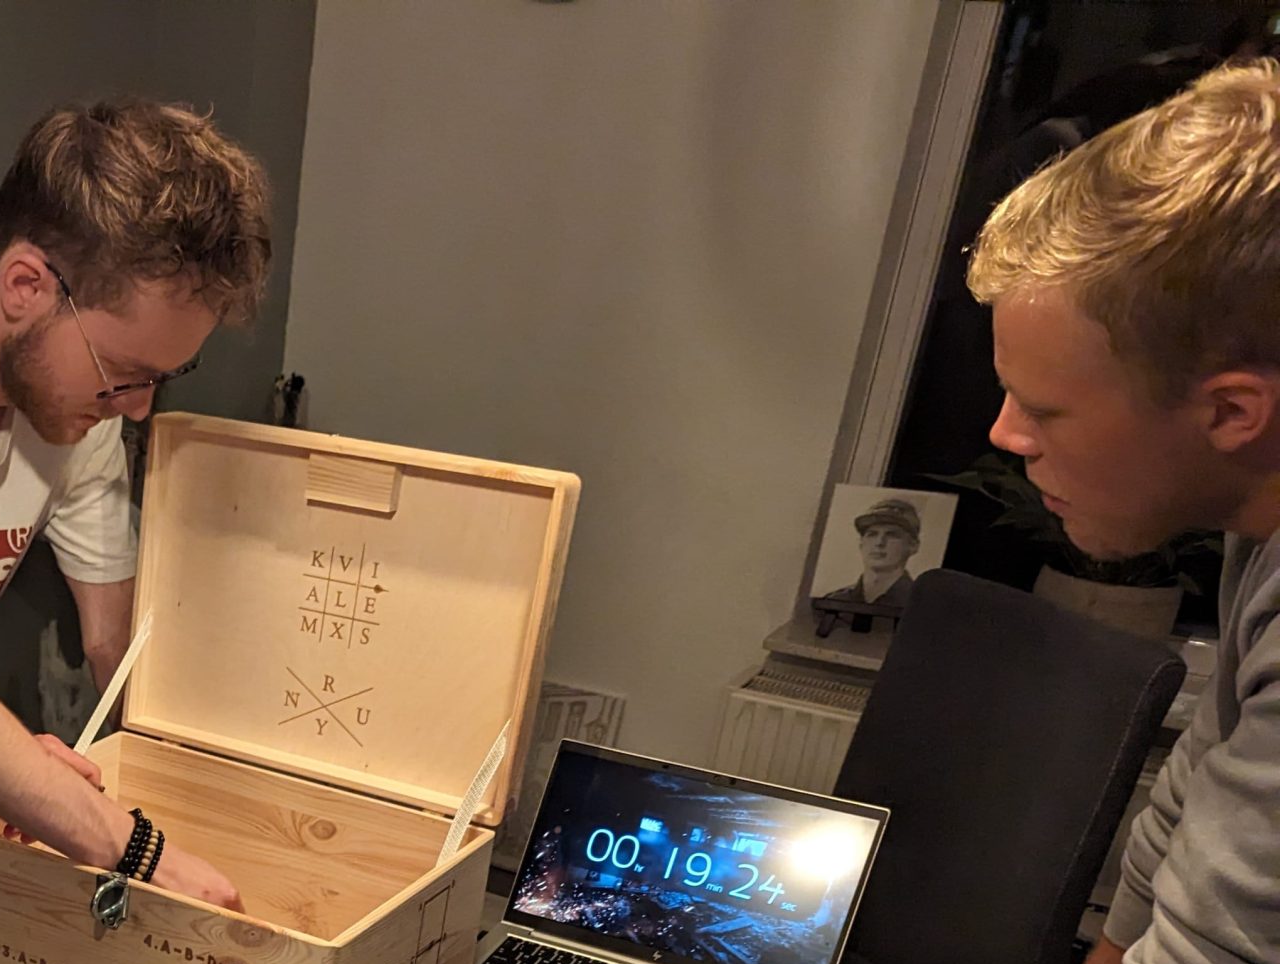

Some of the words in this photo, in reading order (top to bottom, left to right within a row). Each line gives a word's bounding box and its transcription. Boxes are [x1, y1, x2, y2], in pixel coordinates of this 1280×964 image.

[586, 828, 640, 868] 00
[664, 847, 712, 887] 19
[728, 863, 785, 905] 24
